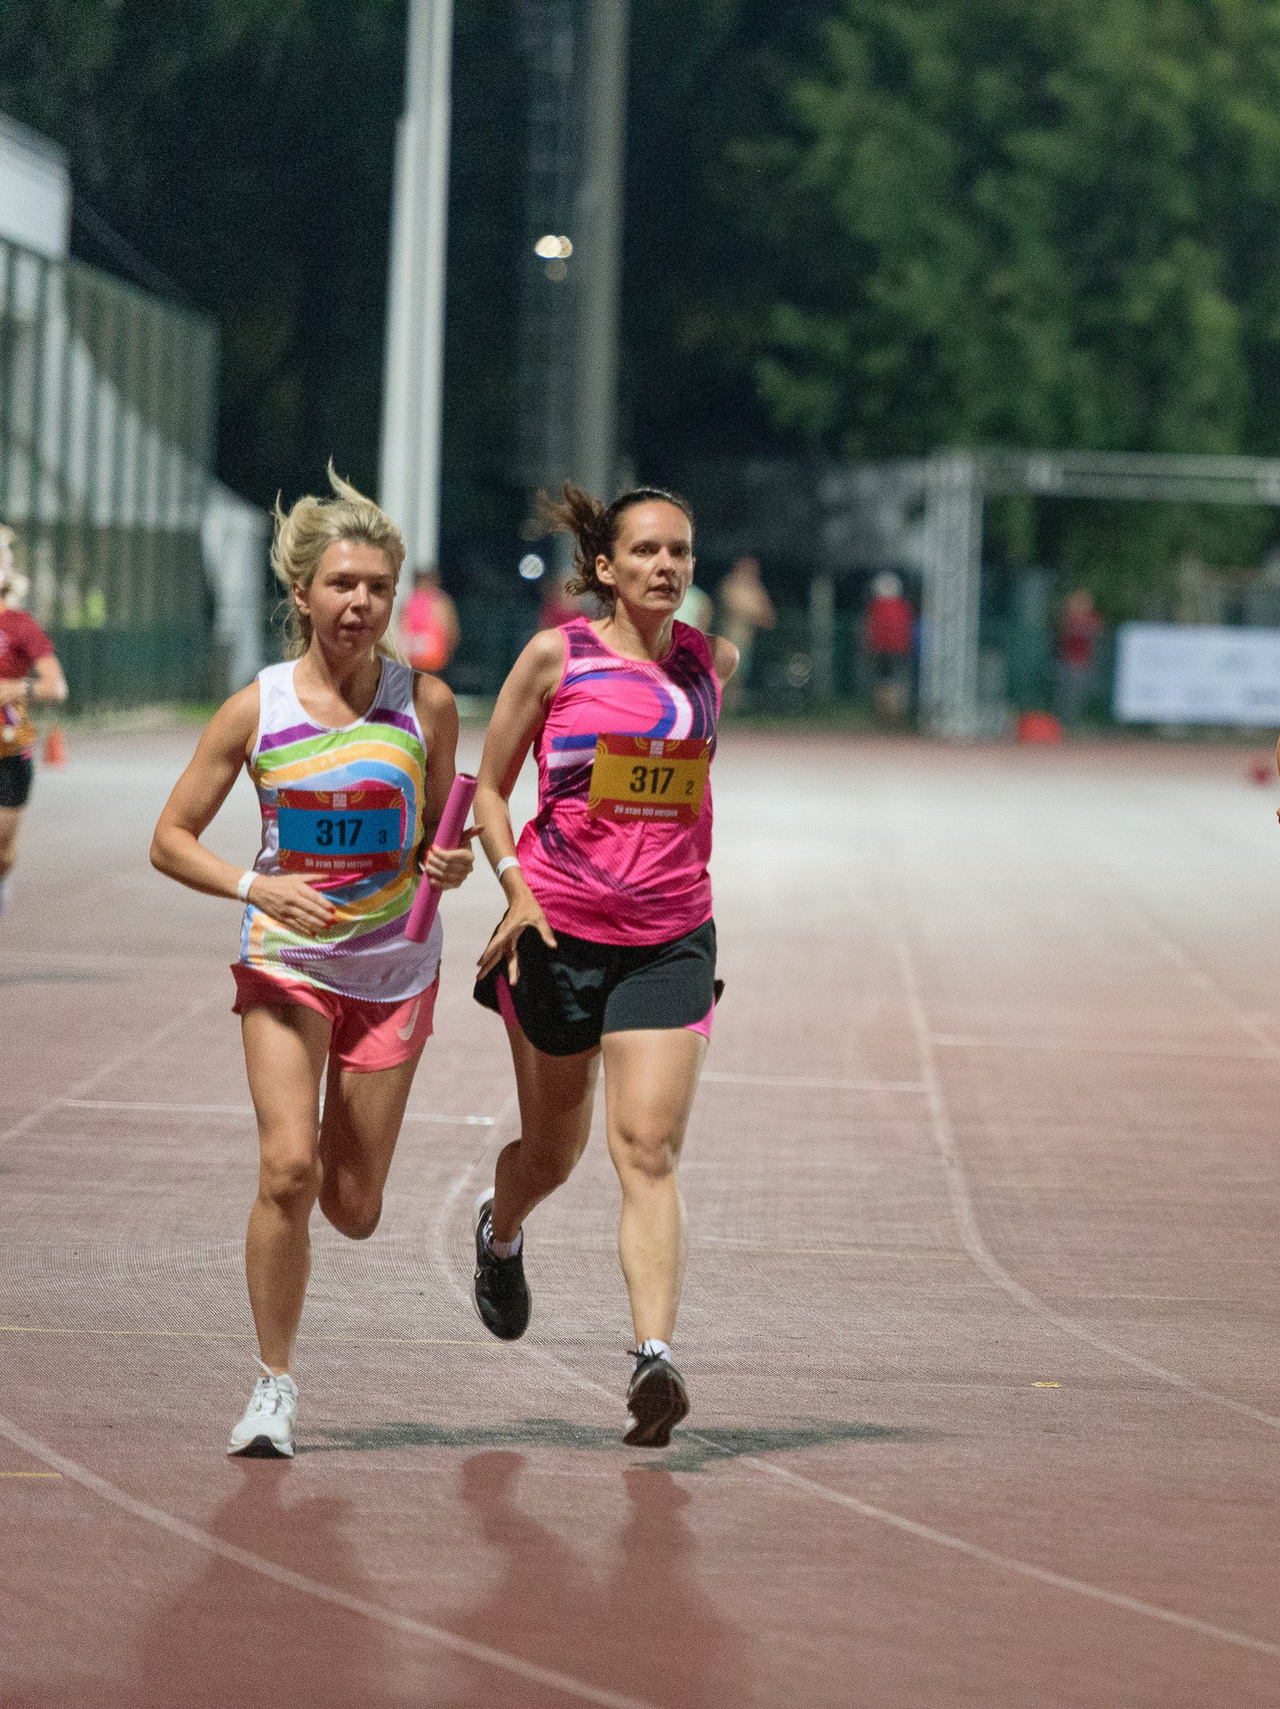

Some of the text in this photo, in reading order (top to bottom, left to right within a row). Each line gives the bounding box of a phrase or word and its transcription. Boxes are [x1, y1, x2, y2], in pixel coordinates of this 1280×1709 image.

[630, 766, 674, 794] 317
[685, 781, 694, 795] 2
[316, 819, 363, 846] 317
[378, 829, 388, 844] 3
